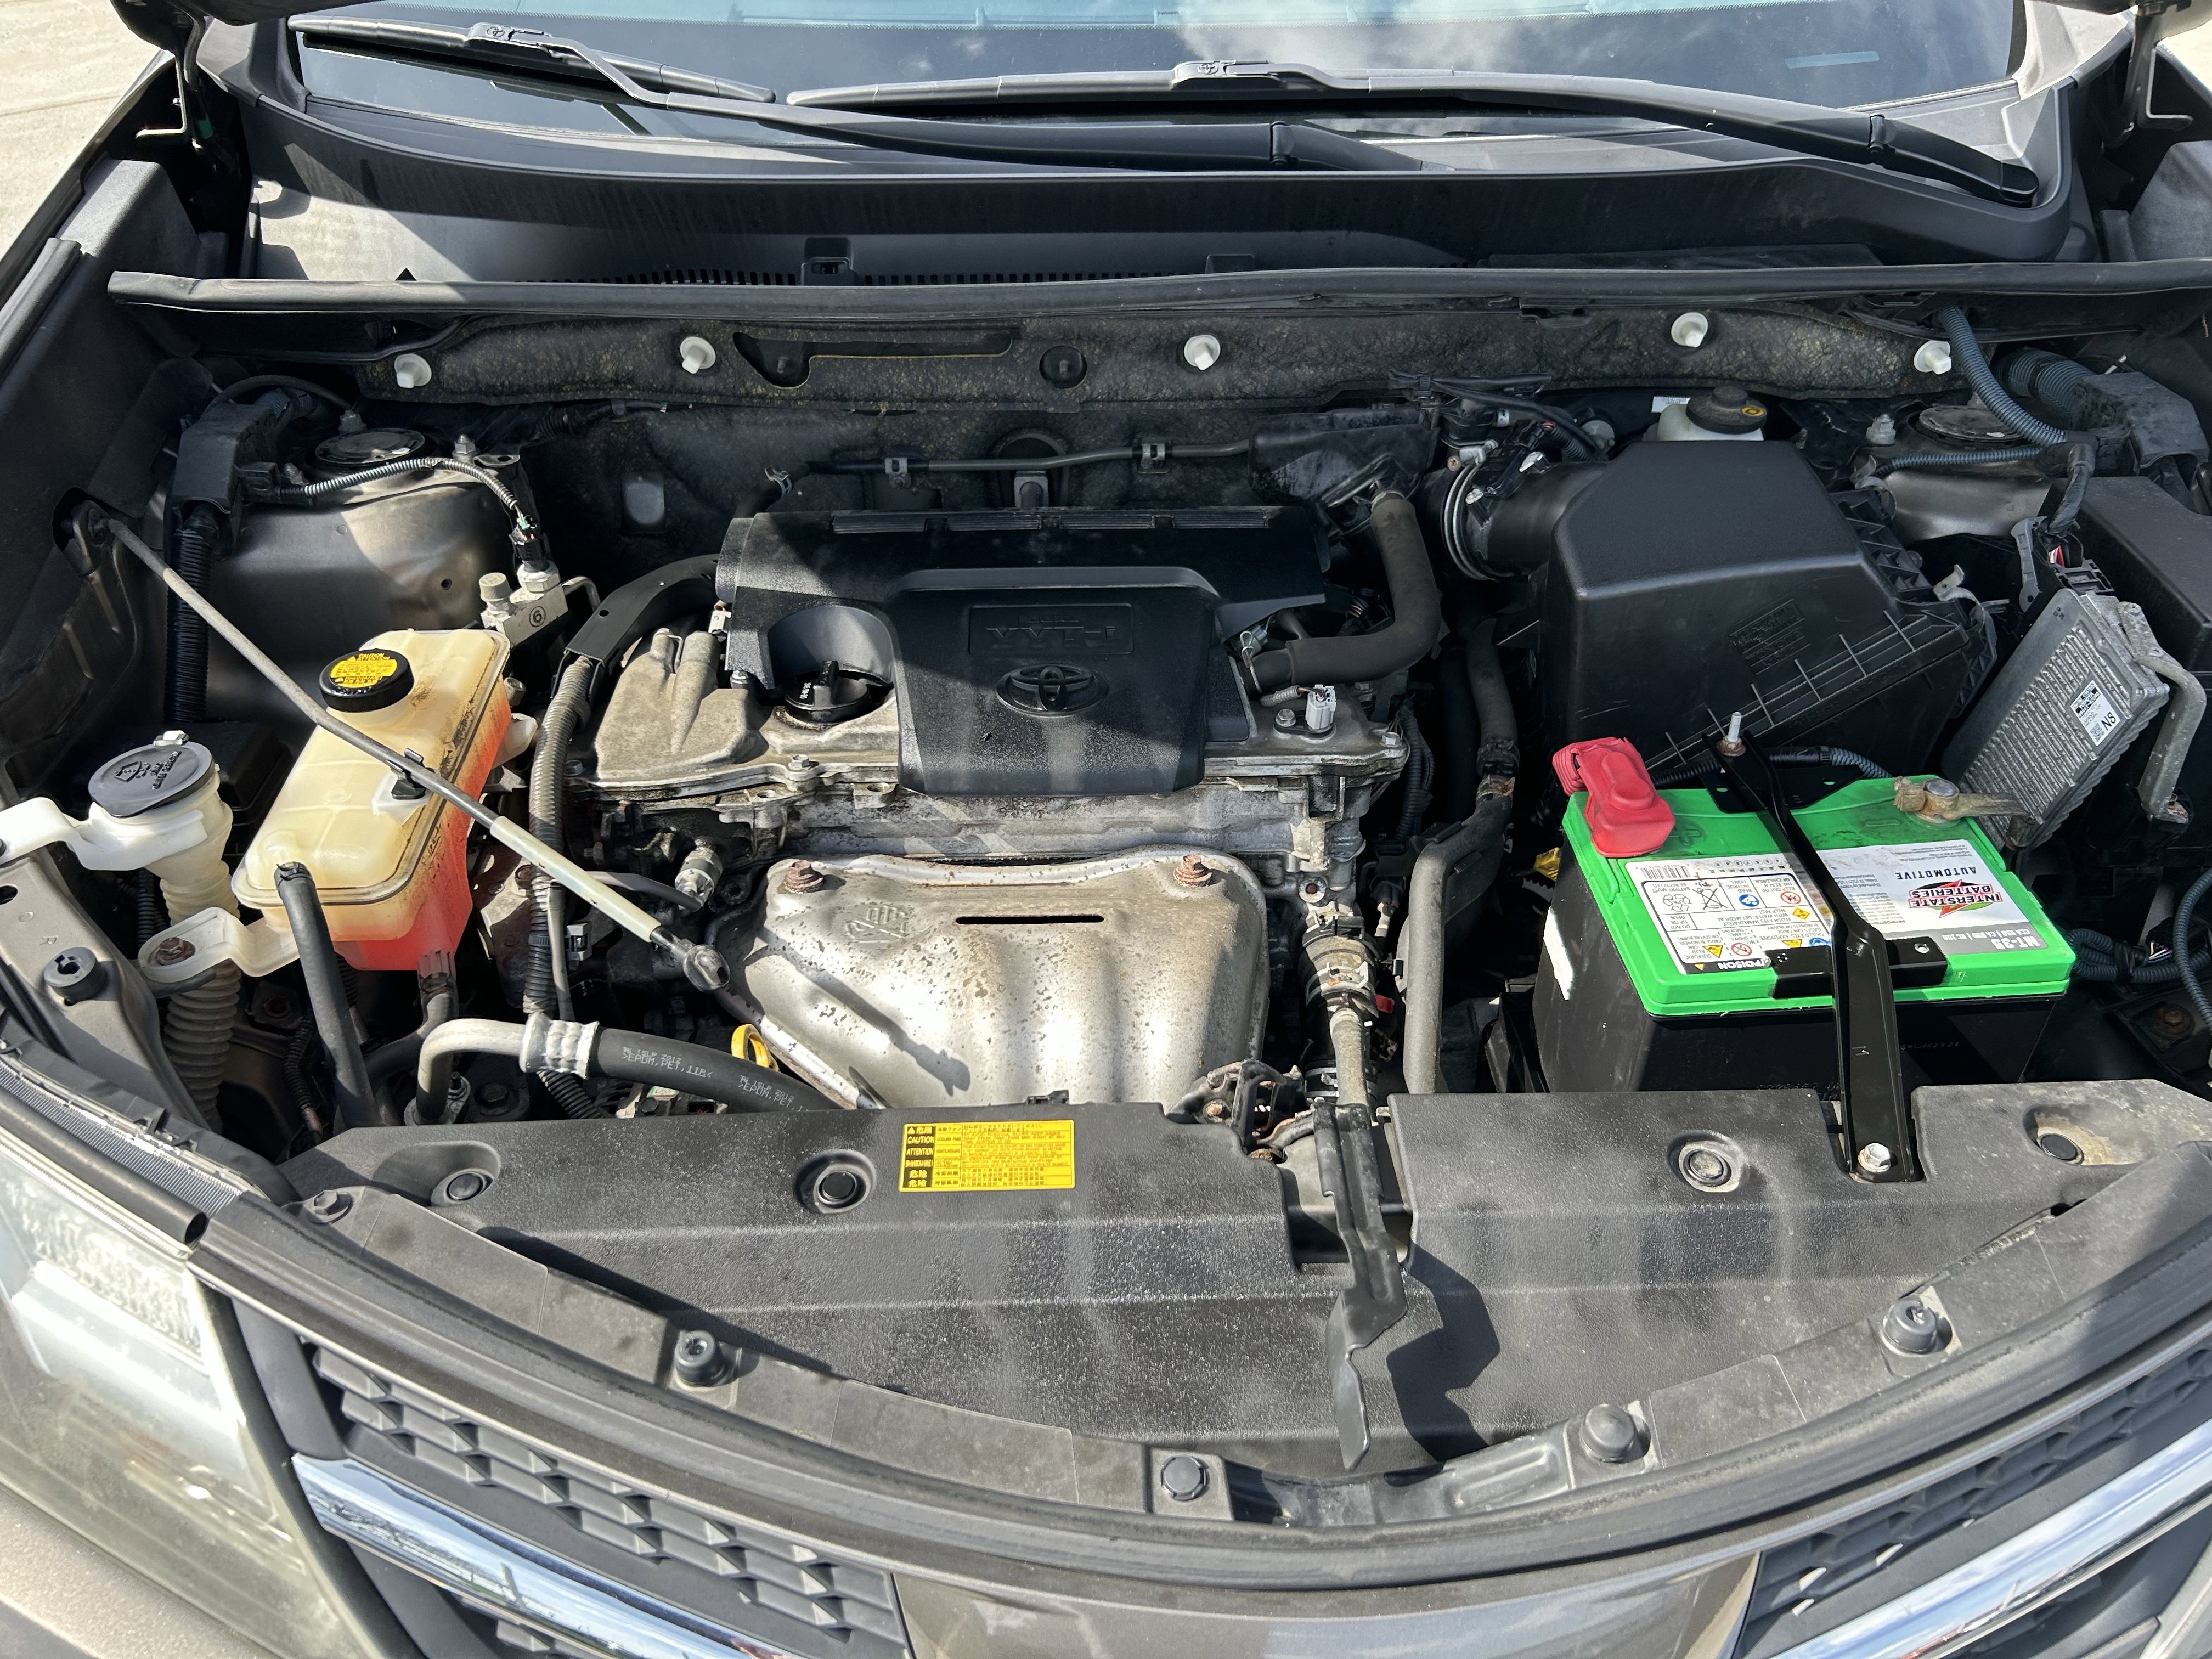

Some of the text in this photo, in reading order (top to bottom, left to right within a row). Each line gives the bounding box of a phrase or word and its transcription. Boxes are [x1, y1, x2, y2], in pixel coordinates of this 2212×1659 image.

[533, 610, 543, 624] 6
[2101, 712, 2117, 731] N8
[1895, 866, 1976, 880] AUTOMOTIVE
[1912, 885, 1991, 898] BATTERIES
[1911, 894, 2000, 907] INTERSTATE
[1991, 935, 2040, 950] MT-35
[907, 1136, 935, 1144] CAUTION
[906, 1148, 934, 1156] ATTENTION
